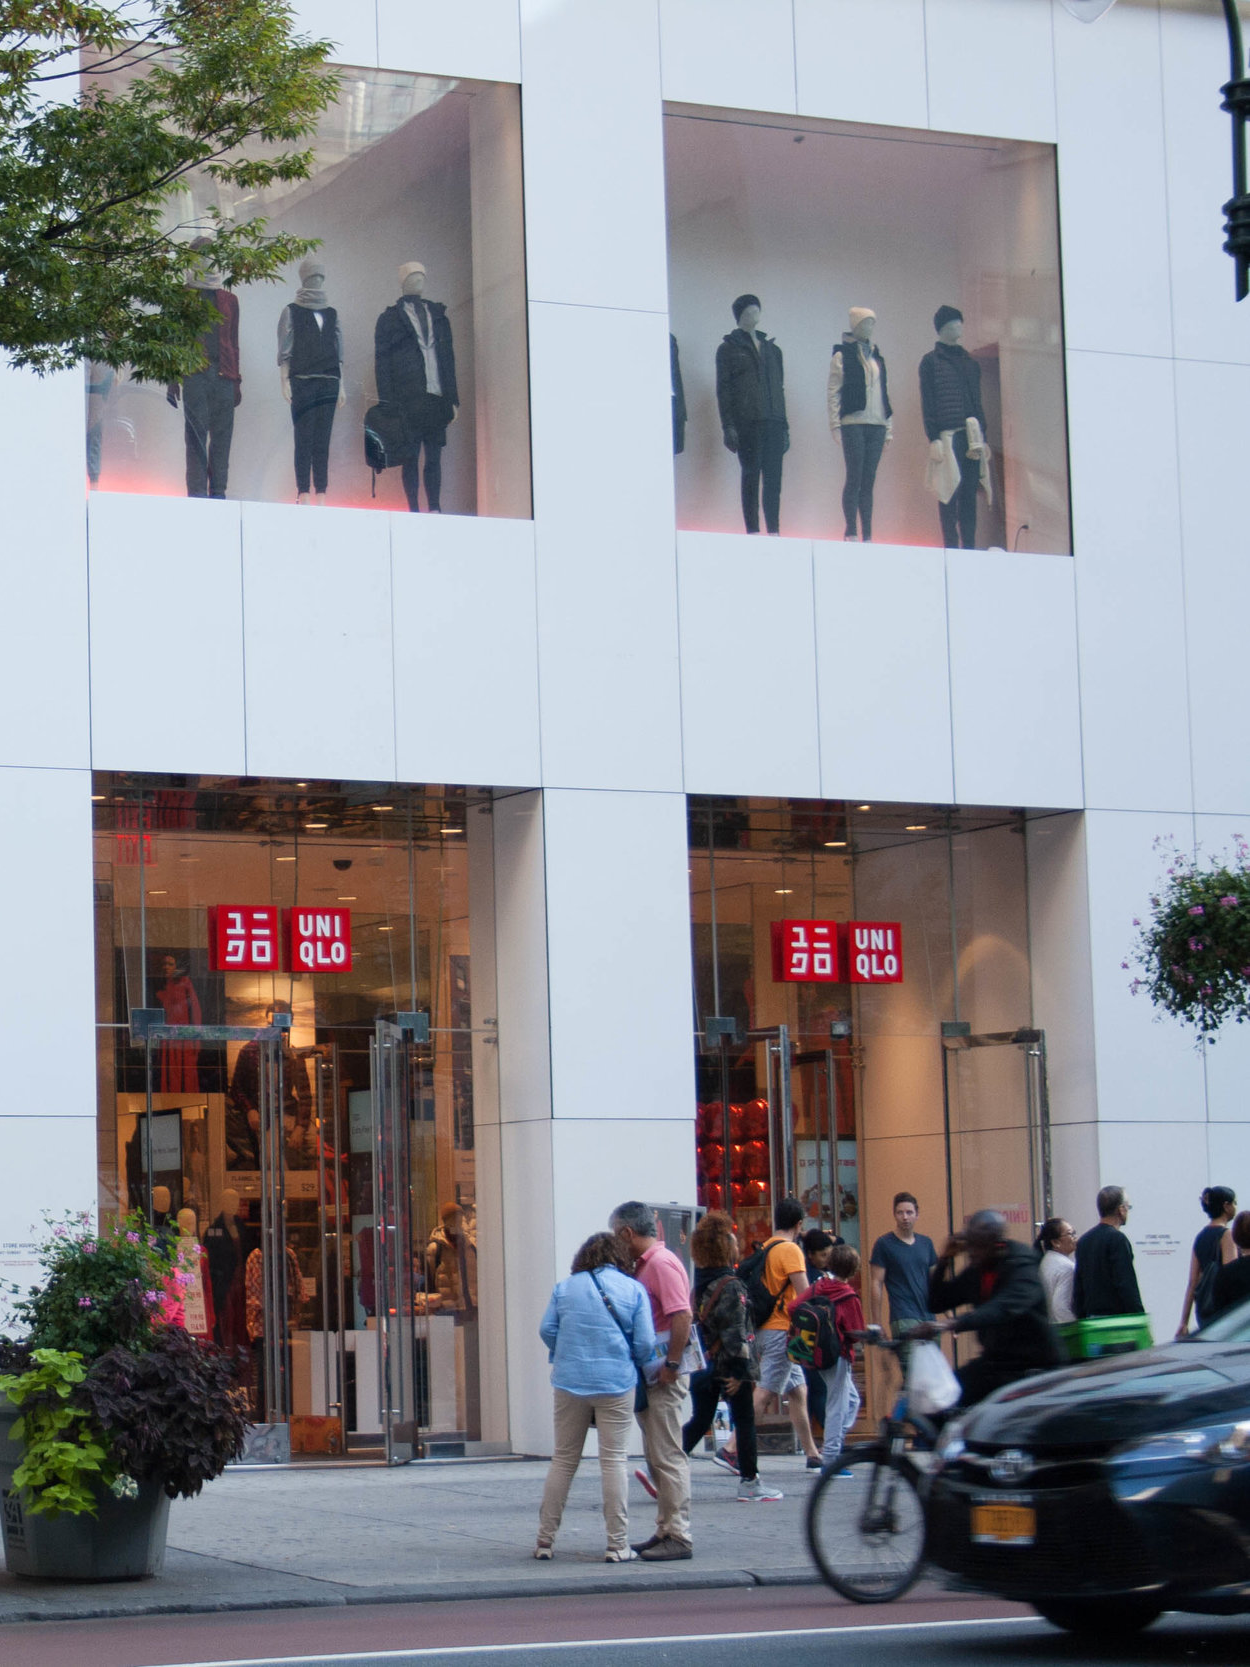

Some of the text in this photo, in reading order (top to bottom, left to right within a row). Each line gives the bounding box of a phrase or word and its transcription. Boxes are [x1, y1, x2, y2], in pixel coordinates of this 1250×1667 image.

[298, 914, 341, 937] UNI
[854, 928, 893, 950] UNI
[299, 941, 345, 967] QLO
[856, 953, 898, 979] QLO
